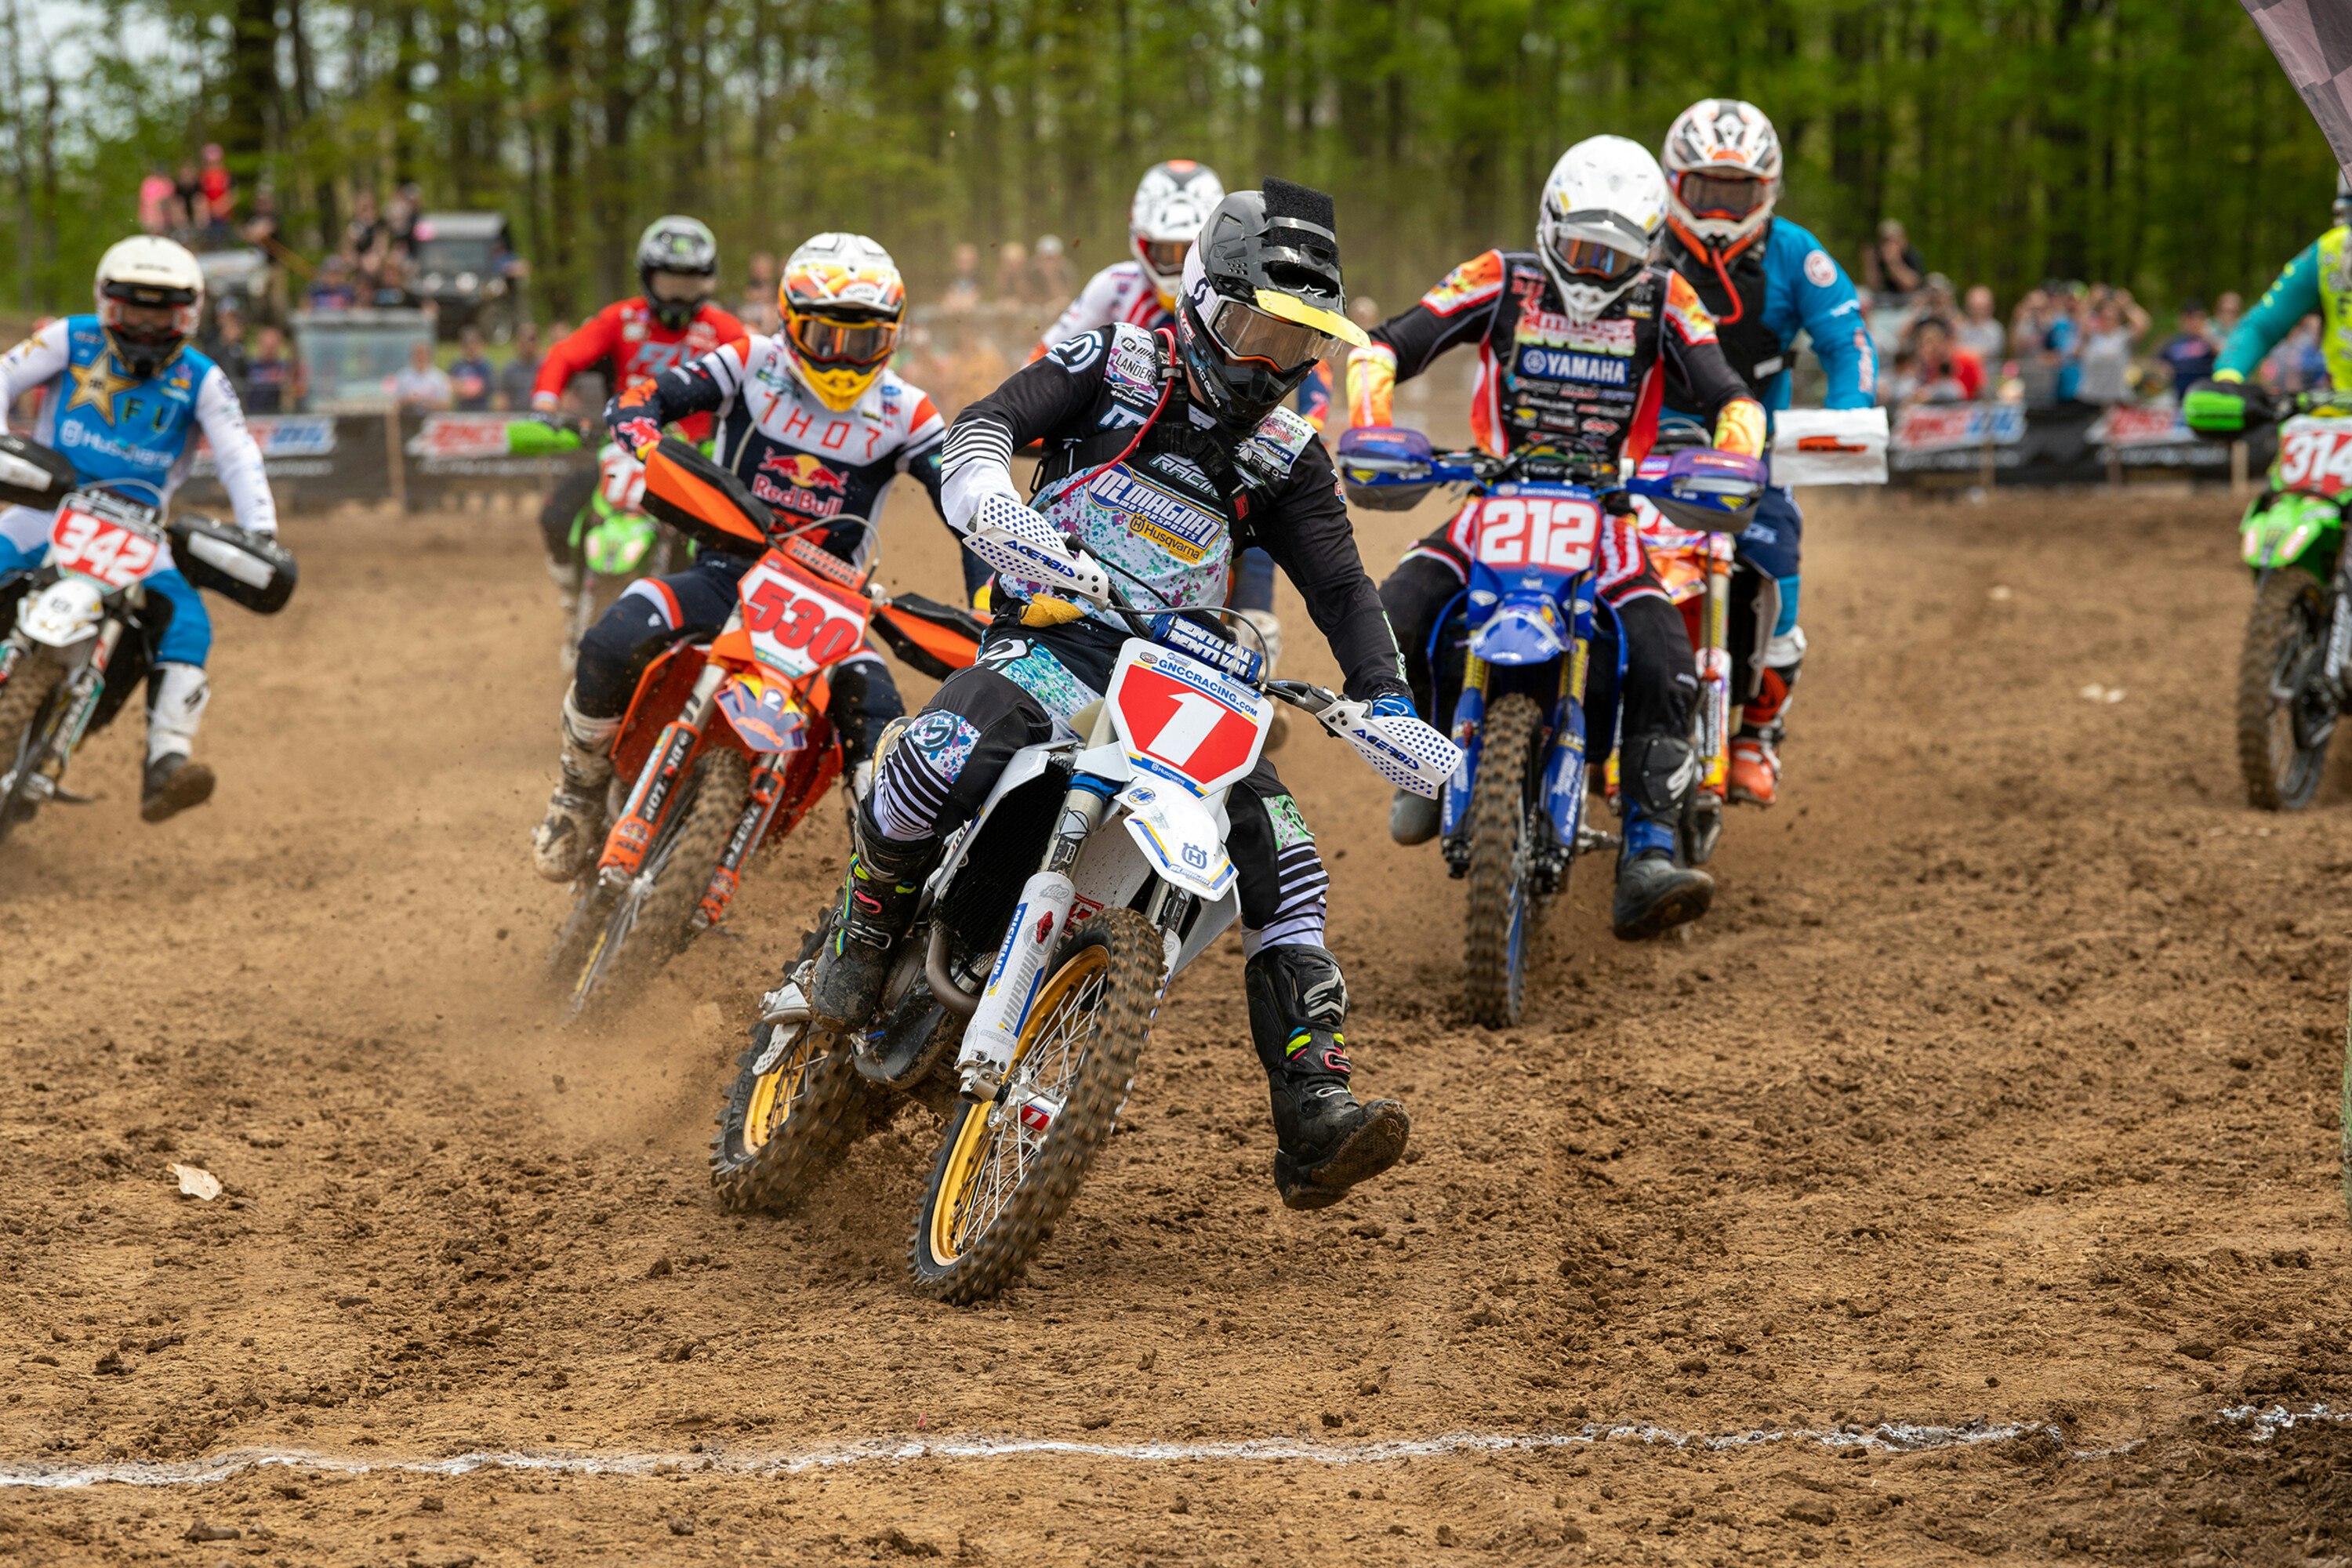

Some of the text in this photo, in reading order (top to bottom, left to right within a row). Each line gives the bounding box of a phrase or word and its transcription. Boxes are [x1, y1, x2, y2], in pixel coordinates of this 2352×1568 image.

[1547, 354, 1626, 385] YAMAHA
[1257, 440, 1290, 460] MICHELIN
[2281, 433, 2352, 487] 314
[752, 473, 844, 518] Red Bull
[1118, 499, 1198, 540] MOTORSPORTS
[56, 513, 156, 587] 342
[1004, 539, 1075, 578] ACERBIS
[1144, 524, 1200, 560] Husqvarna
[1479, 499, 1597, 570] 212
[747, 579, 858, 666] 530
[1168, 615, 1254, 666] RENTHAL
[1163, 630, 1251, 678] RENTHAL
[1146, 691, 1227, 768] 1
[1352, 728, 1420, 771] ACERBIS
[646, 746, 685, 821] DLOP
[993, 909, 1022, 975] MICHELIN
[1024, 1111, 1043, 1125] 1
